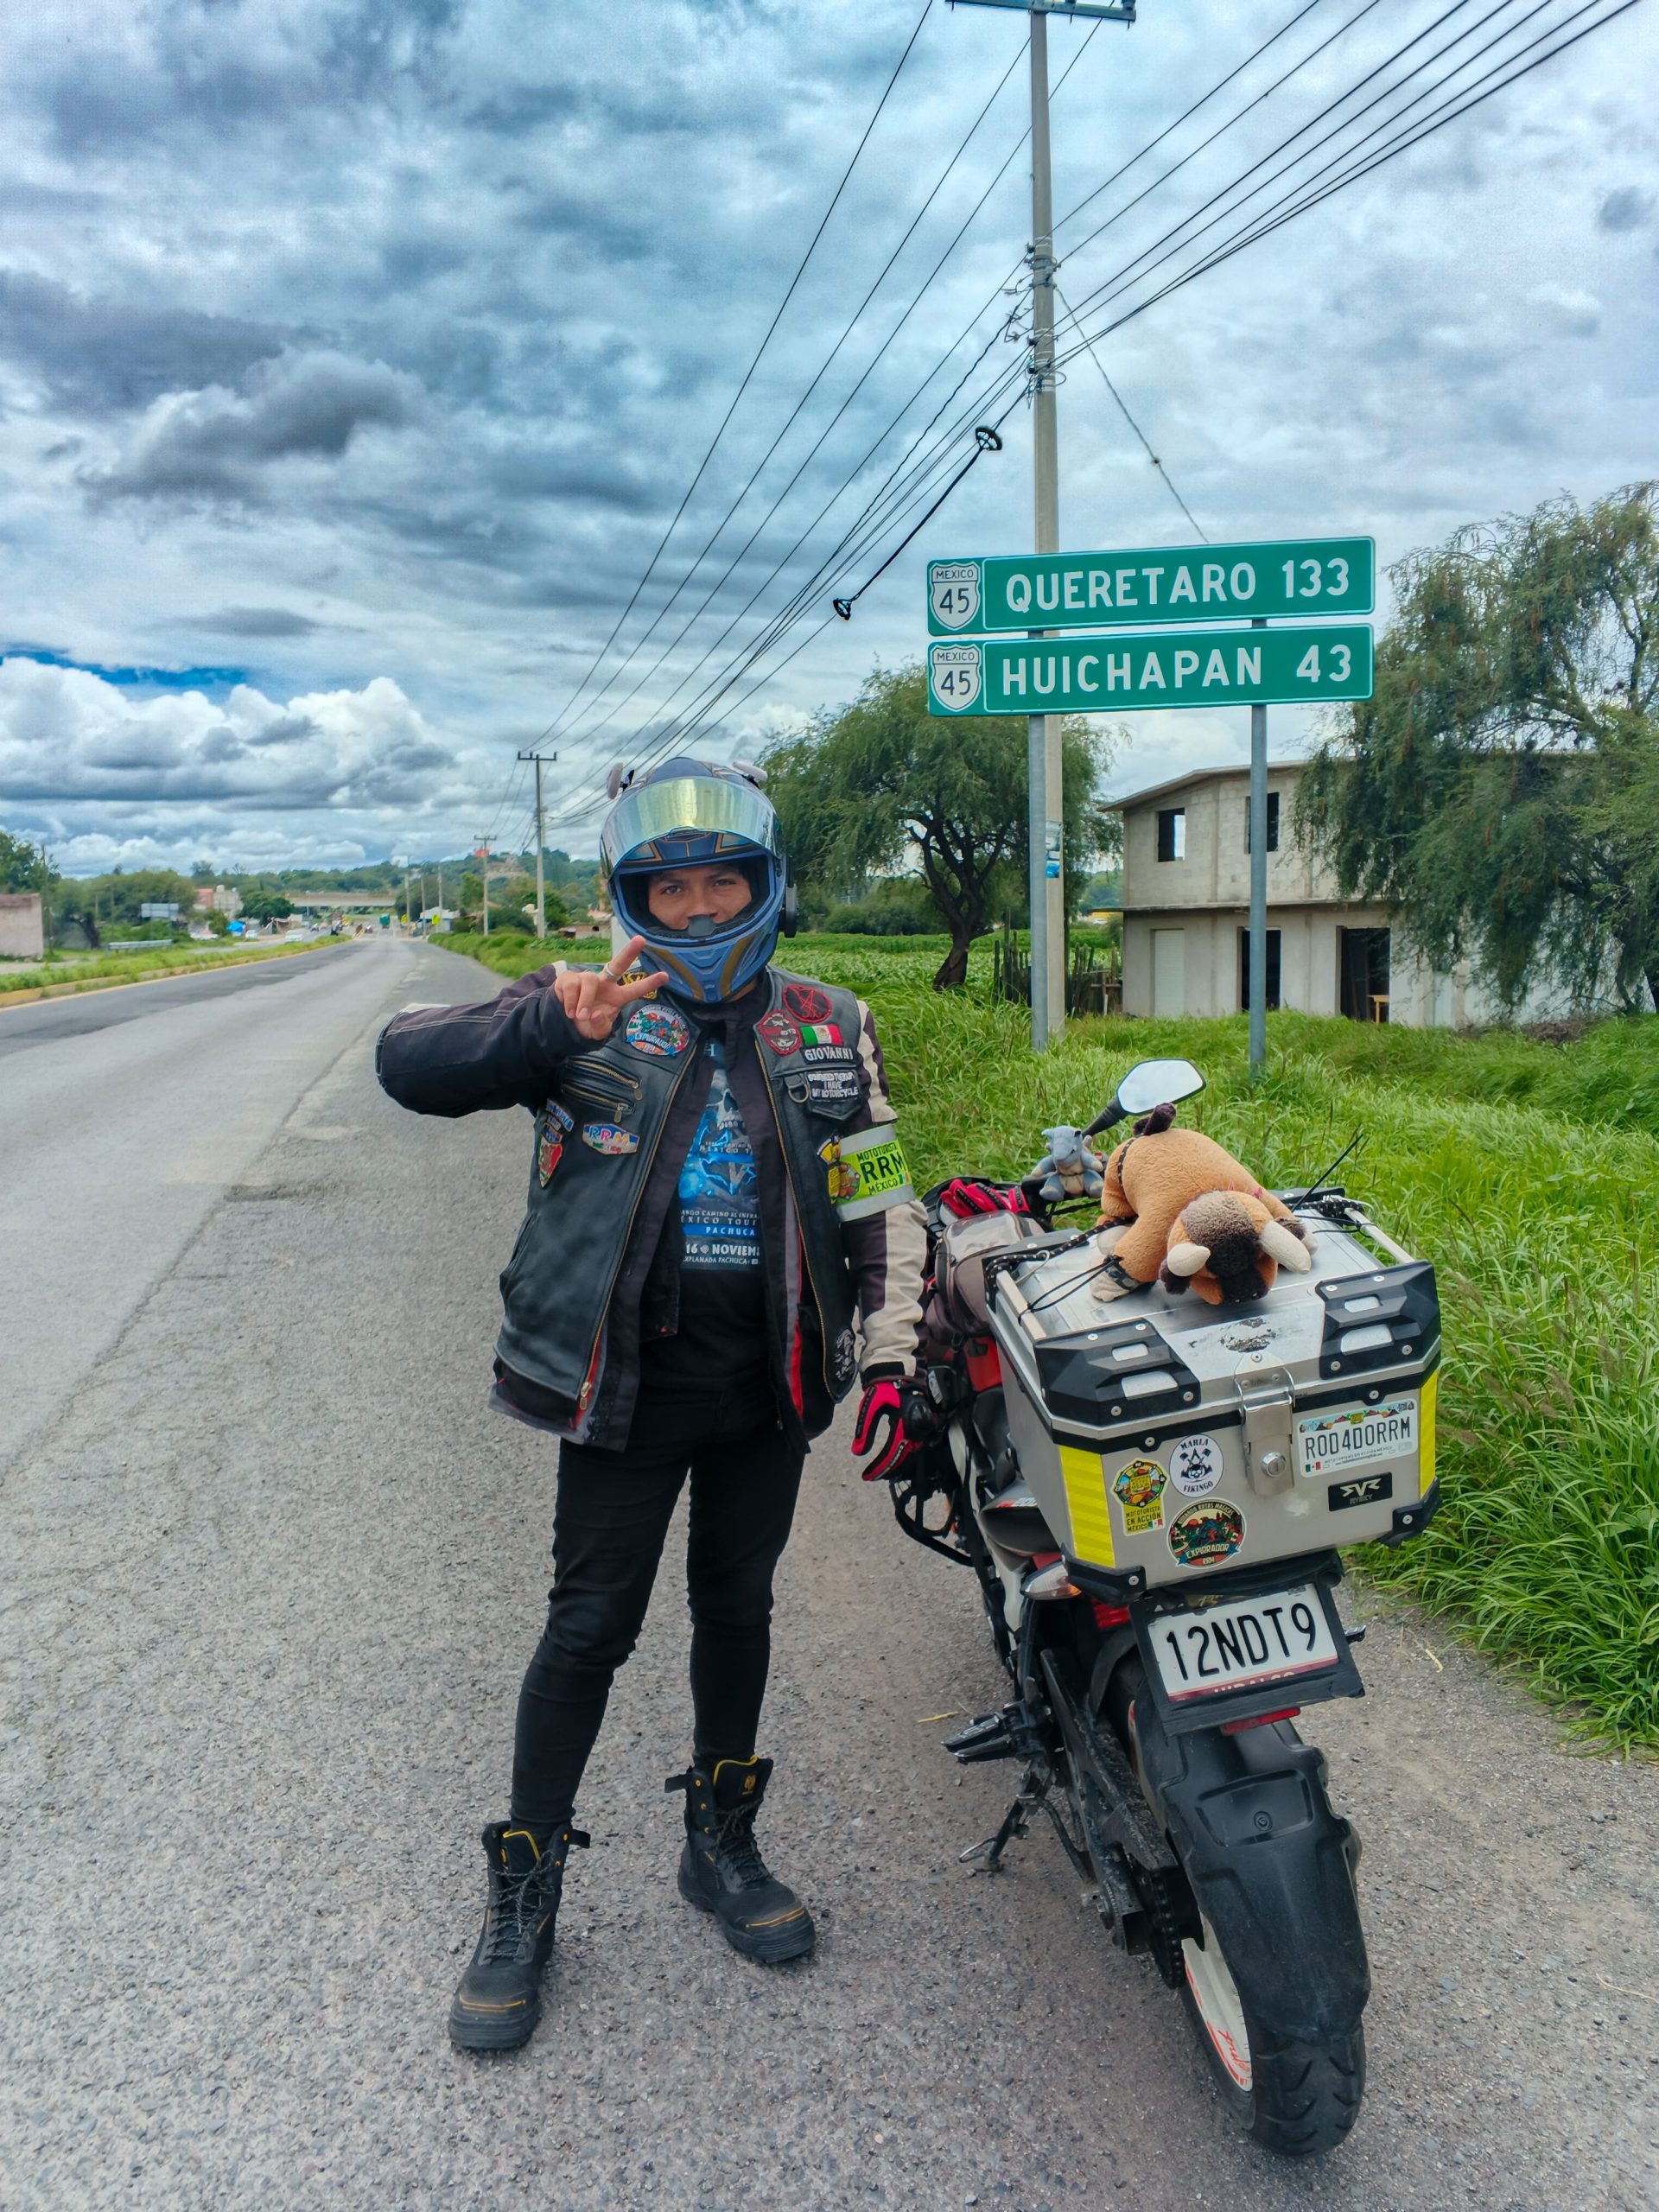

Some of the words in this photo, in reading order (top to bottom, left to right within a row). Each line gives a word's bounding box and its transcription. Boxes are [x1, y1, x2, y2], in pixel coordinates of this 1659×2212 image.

[936, 569, 974, 579] MEXICO
[1006, 562, 1256, 613] QUERETARO
[1281, 557, 1350, 599] 133
[939, 588, 969, 614] 45
[937, 652, 976, 662] MEXICO
[1002, 646, 1262, 696] HUICHAPAN
[1296, 644, 1351, 683] 43
[940, 670, 971, 696] 45
[804, 1046, 854, 1061] GIOVANNI
[821, 1086, 859, 1098] MOTORCYCLE
[588, 1125, 631, 1145] RRM
[860, 1151, 906, 1185] RRM
[705, 1226, 755, 1236] PACHUCA
[685, 1243, 698, 1254] 16
[1126, 1506, 1160, 1517] MOTOTURISTA
[1137, 1512, 1161, 1523] ACCIÓN
[1185, 1543, 1230, 1559] EXPLORADOR
[1166, 1602, 1317, 1681] 12NDT9
